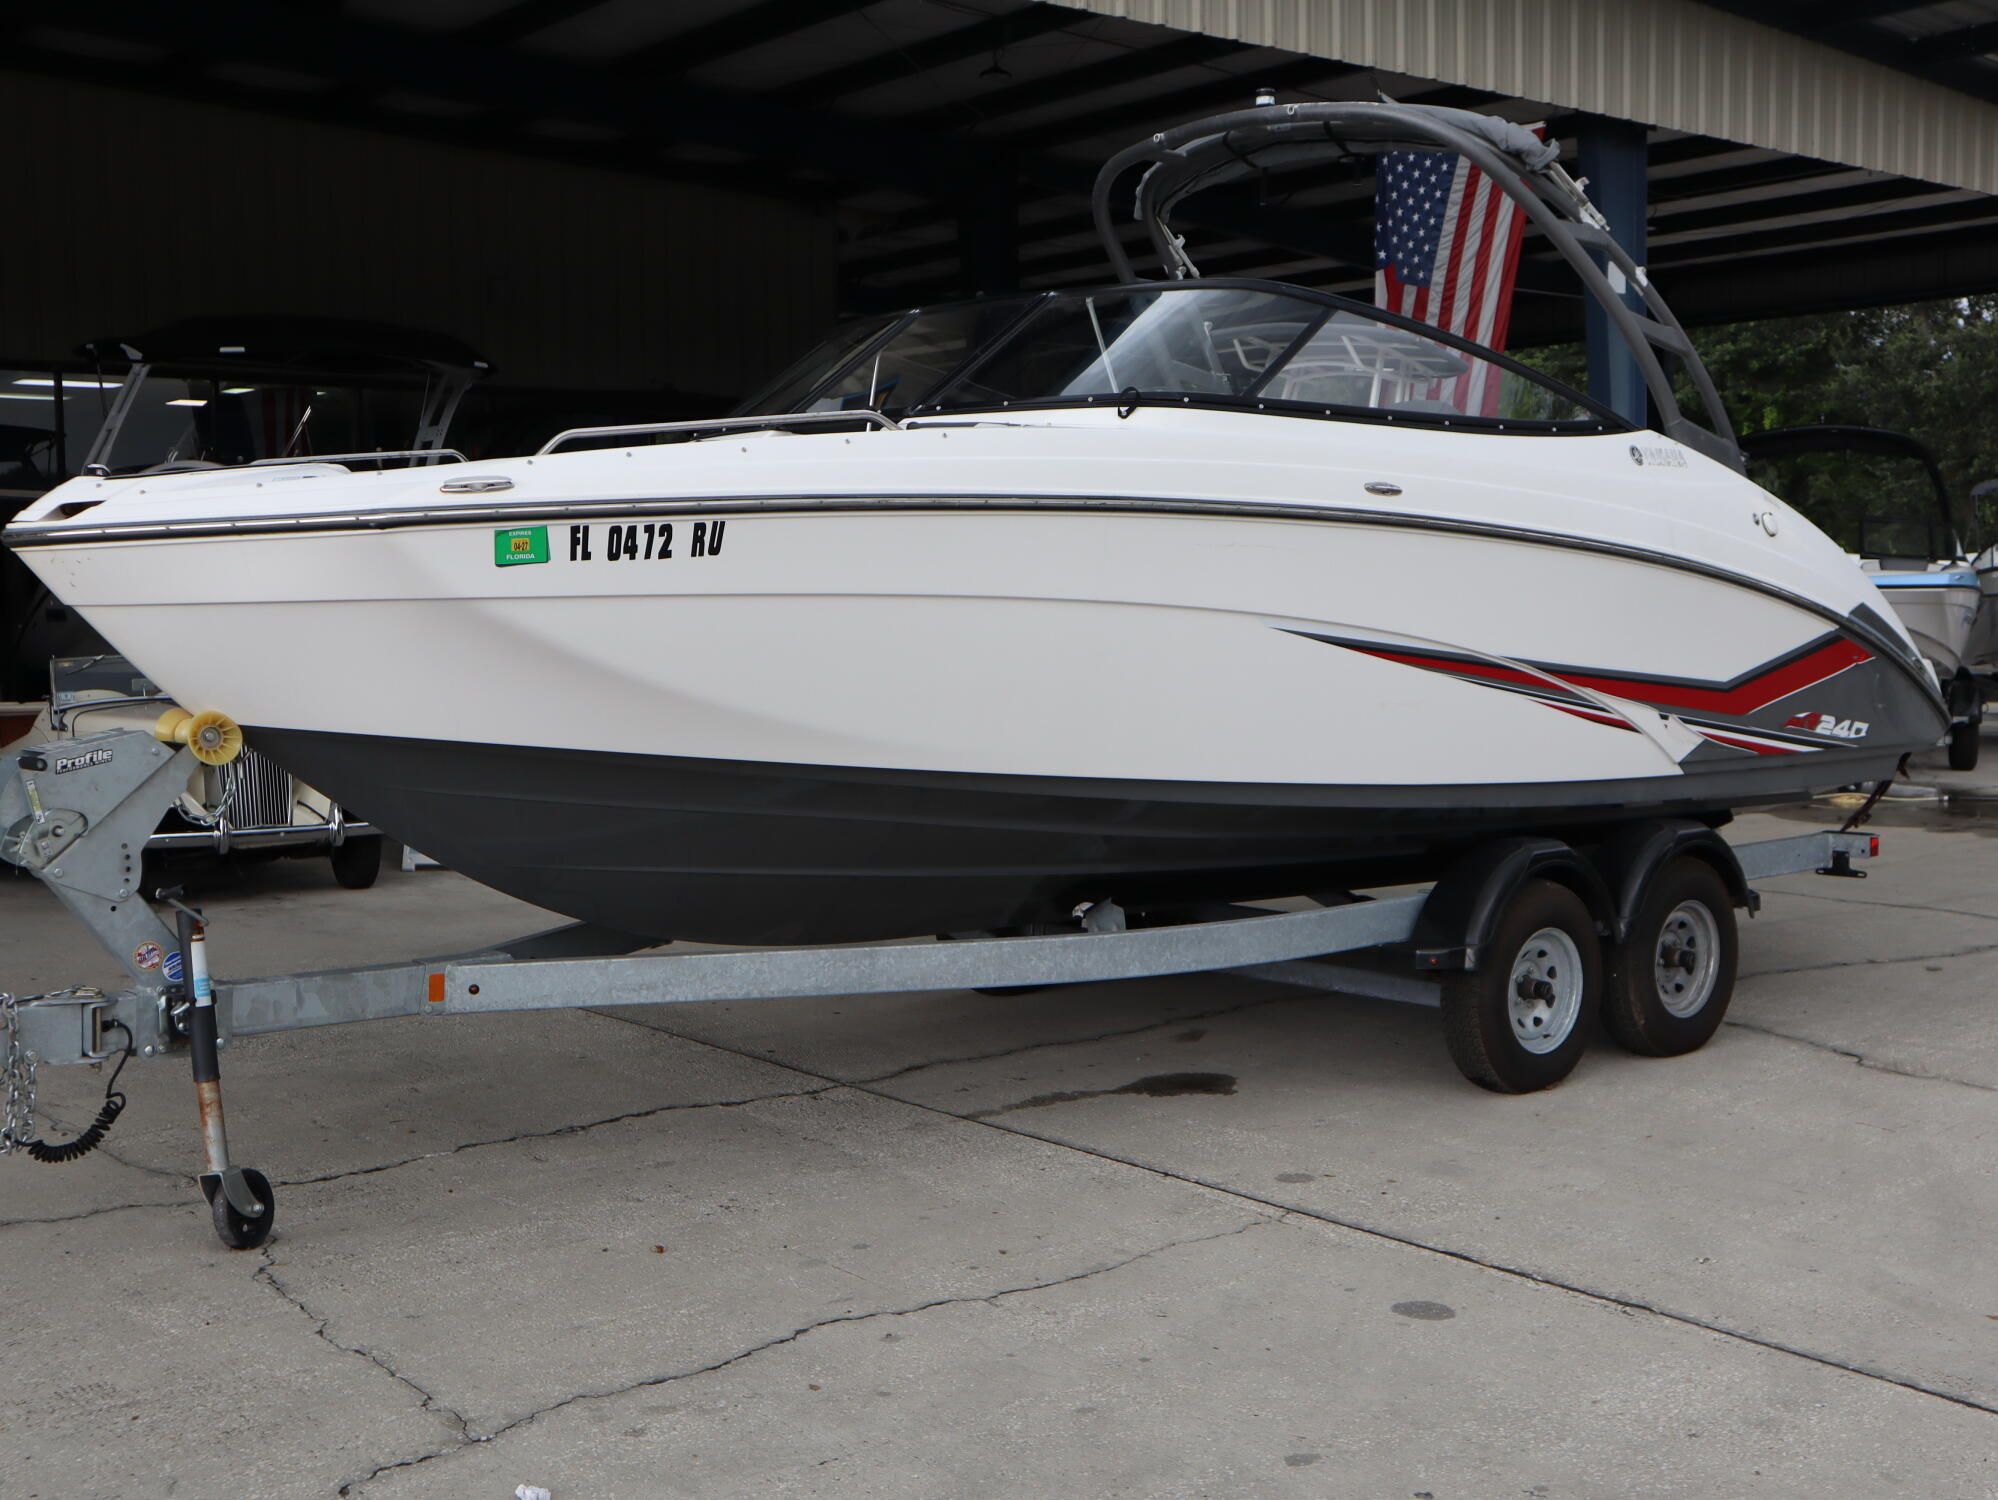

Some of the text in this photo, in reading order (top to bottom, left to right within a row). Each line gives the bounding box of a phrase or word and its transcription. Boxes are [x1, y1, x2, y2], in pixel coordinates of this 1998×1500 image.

[570, 520, 726, 561] FL 0472 RU
[1814, 714, 1869, 738] 240
[56, 749, 112, 770] Profile
